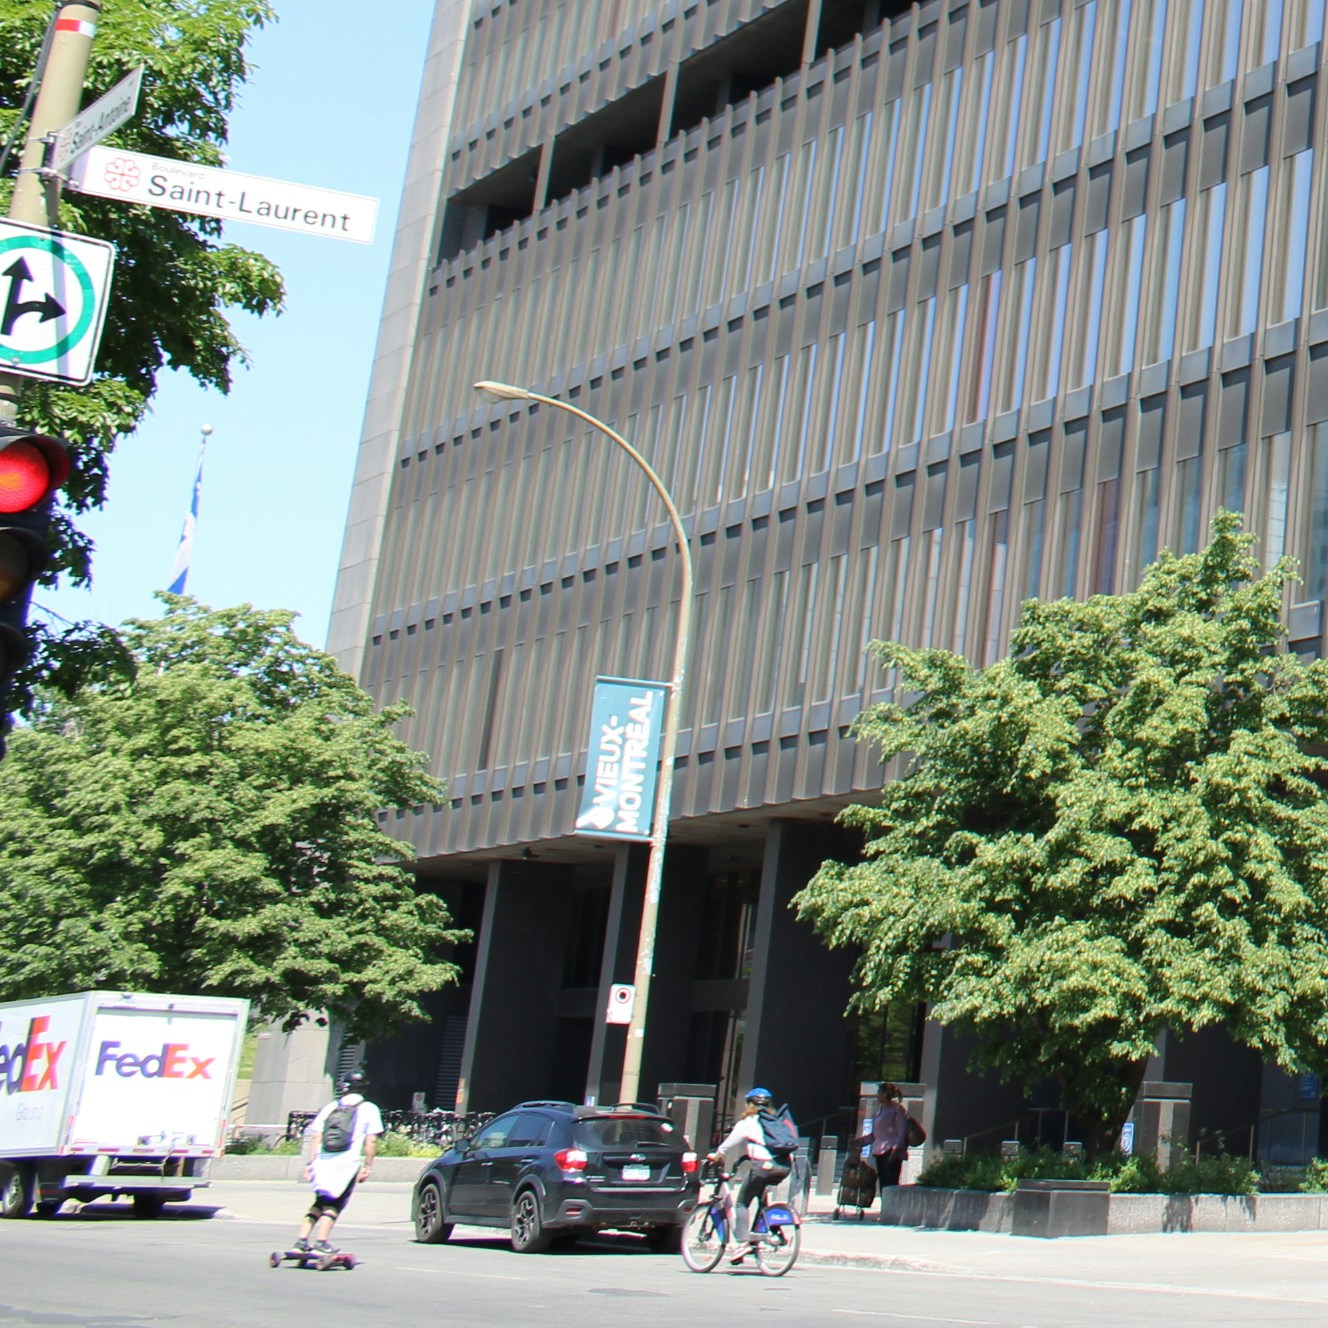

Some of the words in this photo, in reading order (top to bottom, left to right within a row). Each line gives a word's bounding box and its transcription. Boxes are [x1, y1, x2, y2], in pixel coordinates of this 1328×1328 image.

[151, 162, 205, 180] Boulevard
[148, 174, 351, 232] Saint-Laurent
[592, 715, 625, 805] VIEUX-
[0, 1015, 68, 1096] edEx
[95, 1040, 216, 1080] FedEx
